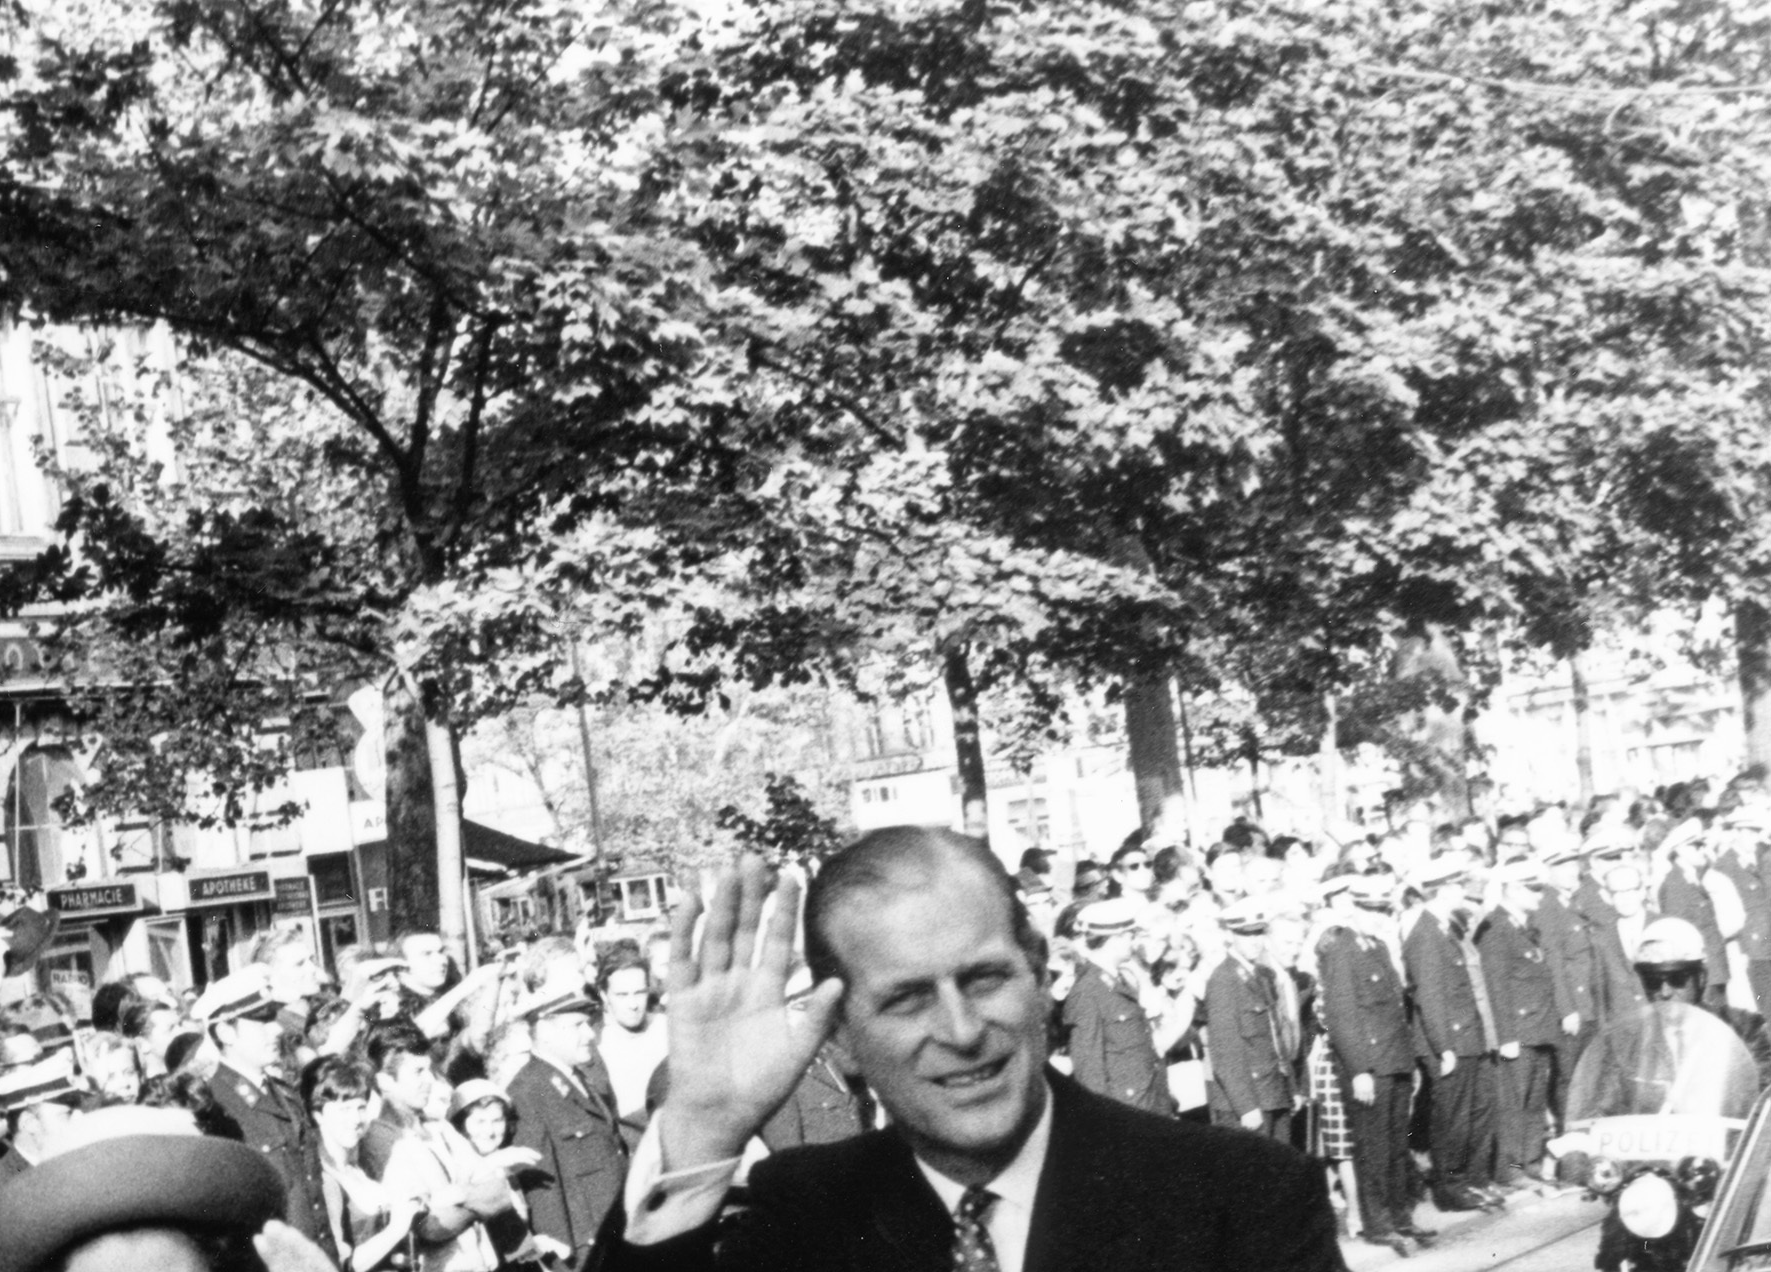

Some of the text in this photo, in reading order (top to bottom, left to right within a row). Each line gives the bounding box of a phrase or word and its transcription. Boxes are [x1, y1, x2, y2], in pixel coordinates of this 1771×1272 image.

[202, 876, 257, 896] APOTHEKE
[60, 888, 124, 909] PHARMACIE
[1599, 1130, 1714, 1155] POLIZEI
